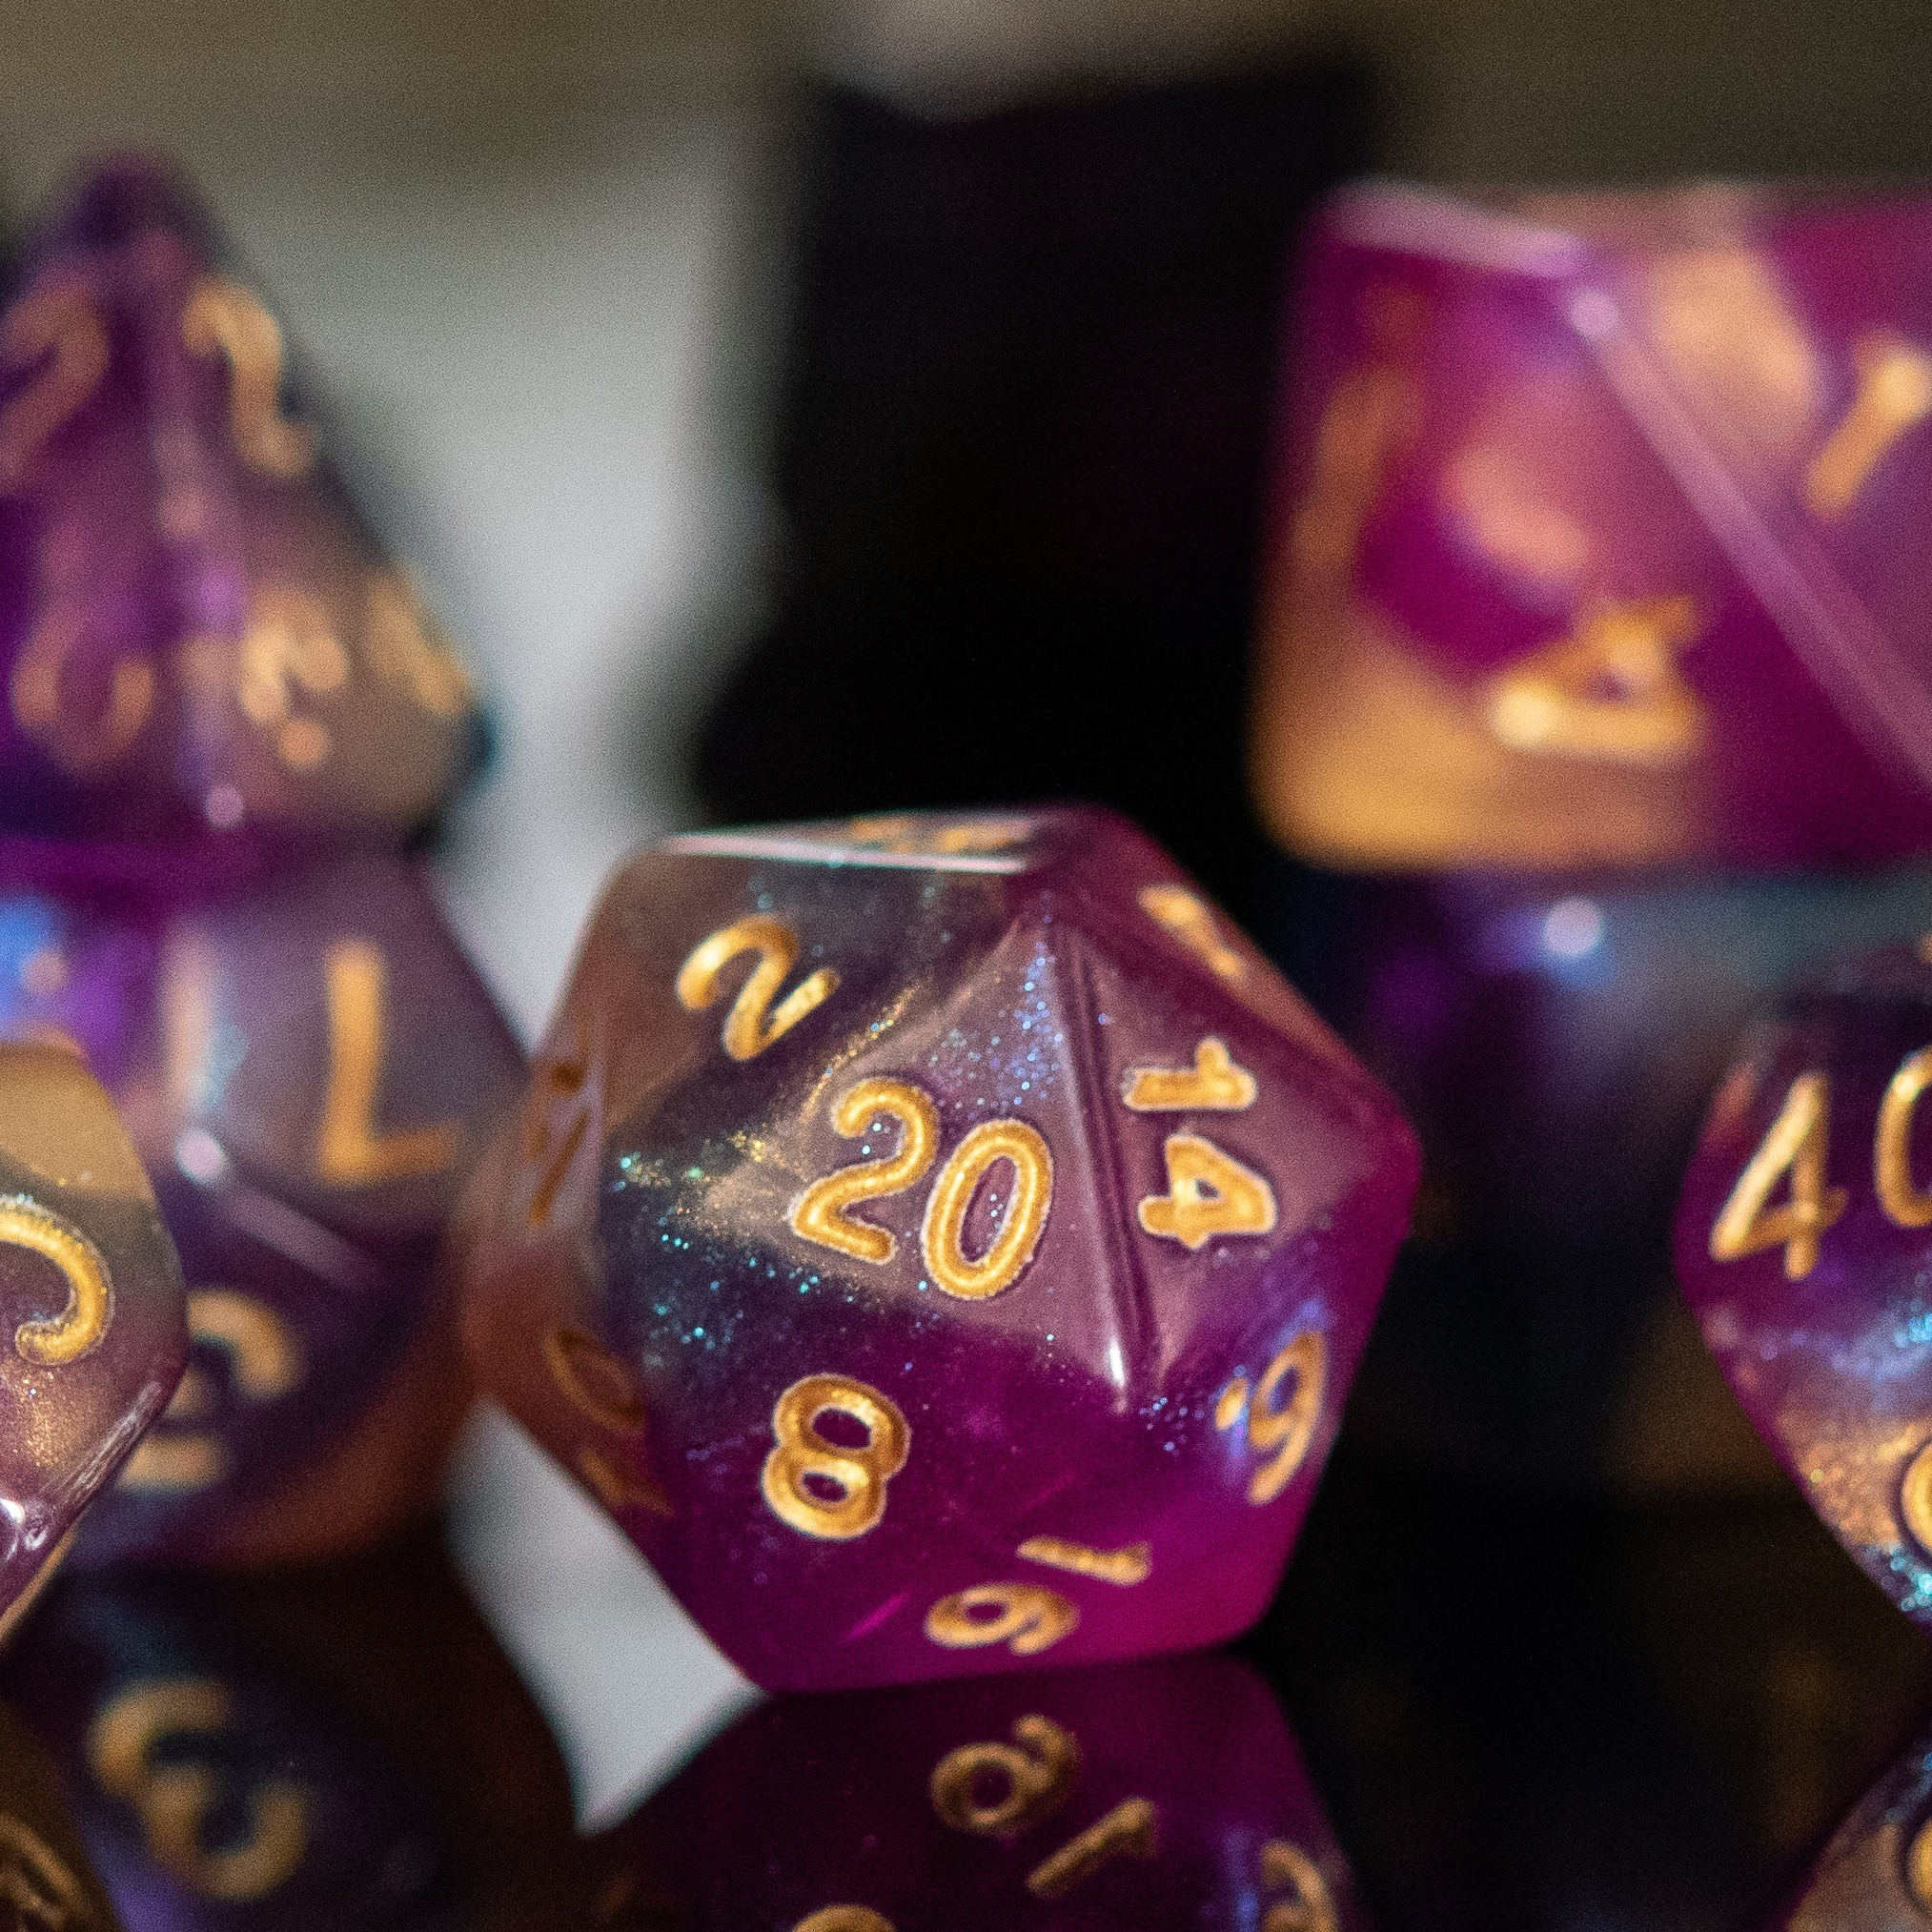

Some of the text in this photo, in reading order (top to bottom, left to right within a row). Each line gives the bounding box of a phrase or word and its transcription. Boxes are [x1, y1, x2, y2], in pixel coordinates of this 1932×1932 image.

[676, 912, 841, 1063] 2
[787, 1075, 1053, 1302] 20
[1121, 1034, 1278, 1251] 14
[761, 1372, 911, 1542] 8
